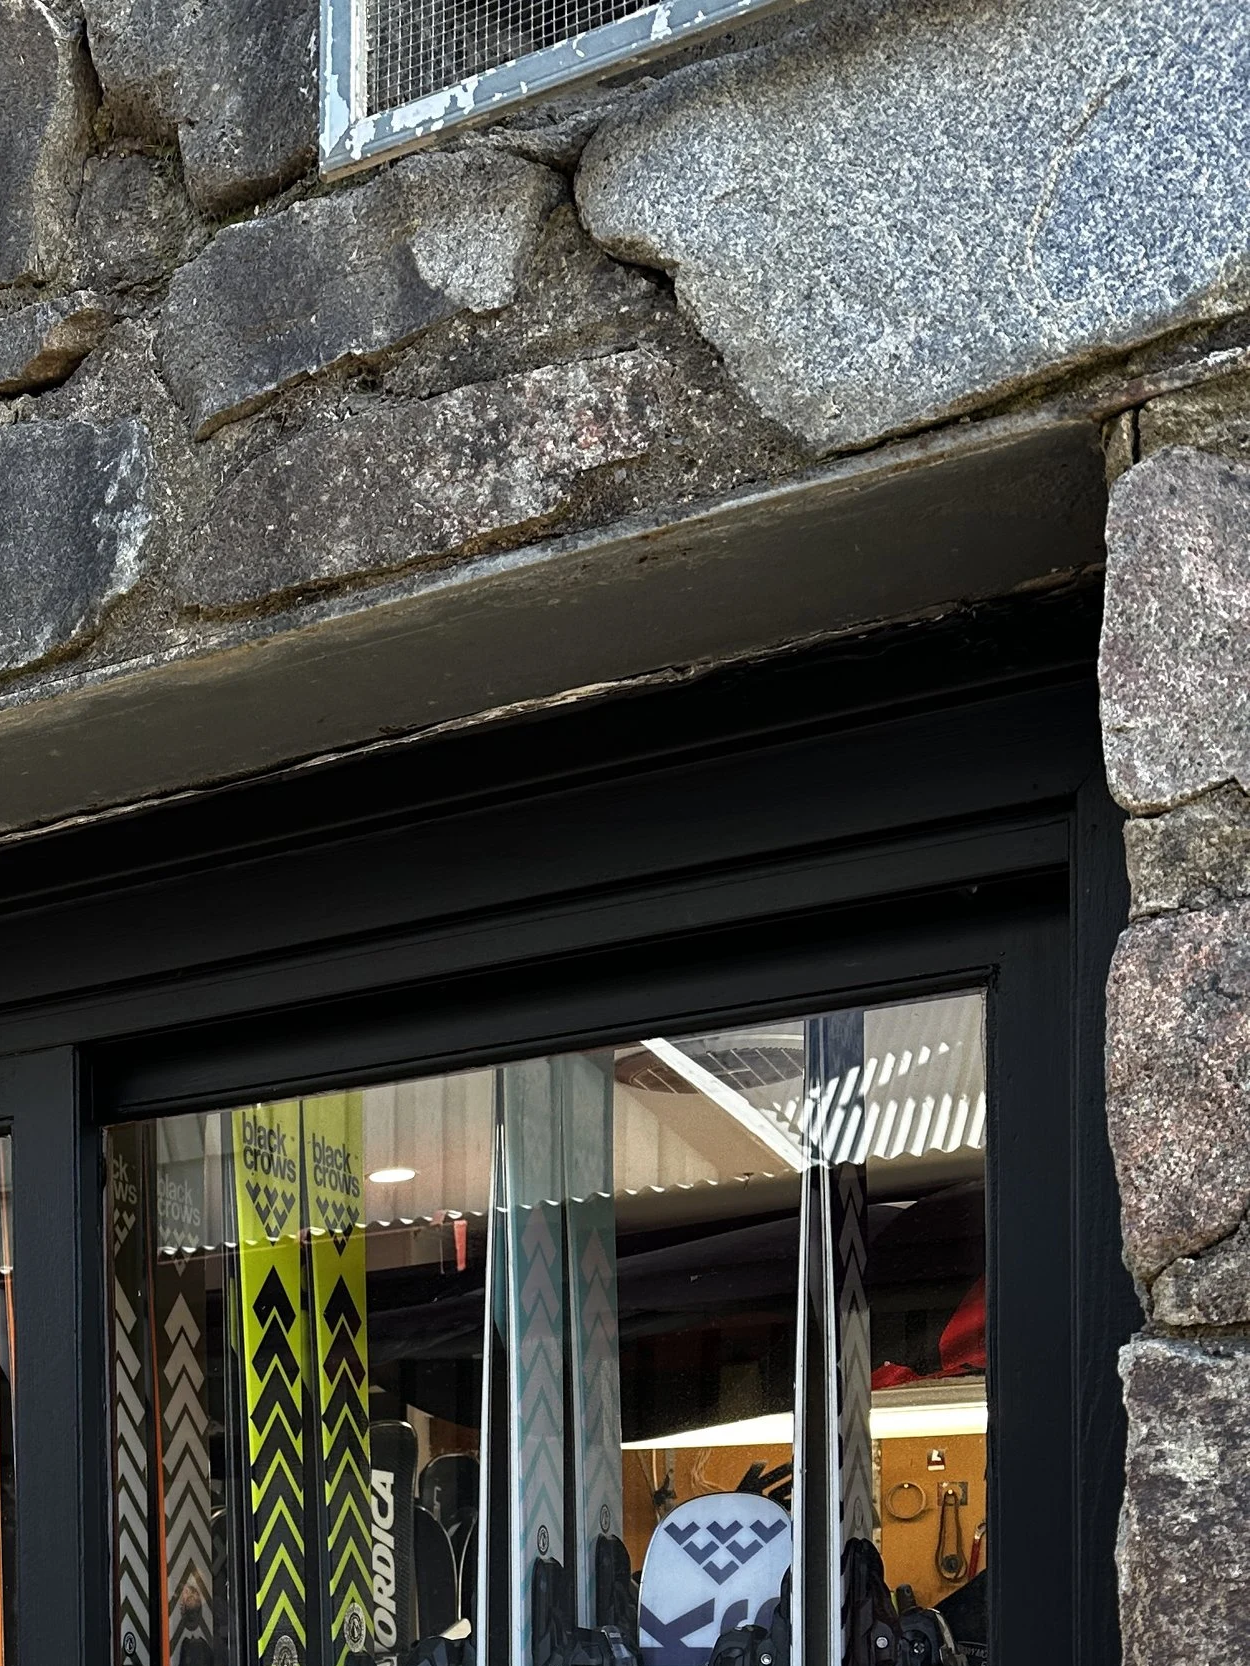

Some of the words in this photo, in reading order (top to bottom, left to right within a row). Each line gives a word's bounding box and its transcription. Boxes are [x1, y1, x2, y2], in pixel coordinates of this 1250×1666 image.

[242, 1111, 287, 1157] black
[312, 1132, 352, 1174] black
[243, 1145, 296, 1184] crows
[313, 1164, 360, 1198] crows
